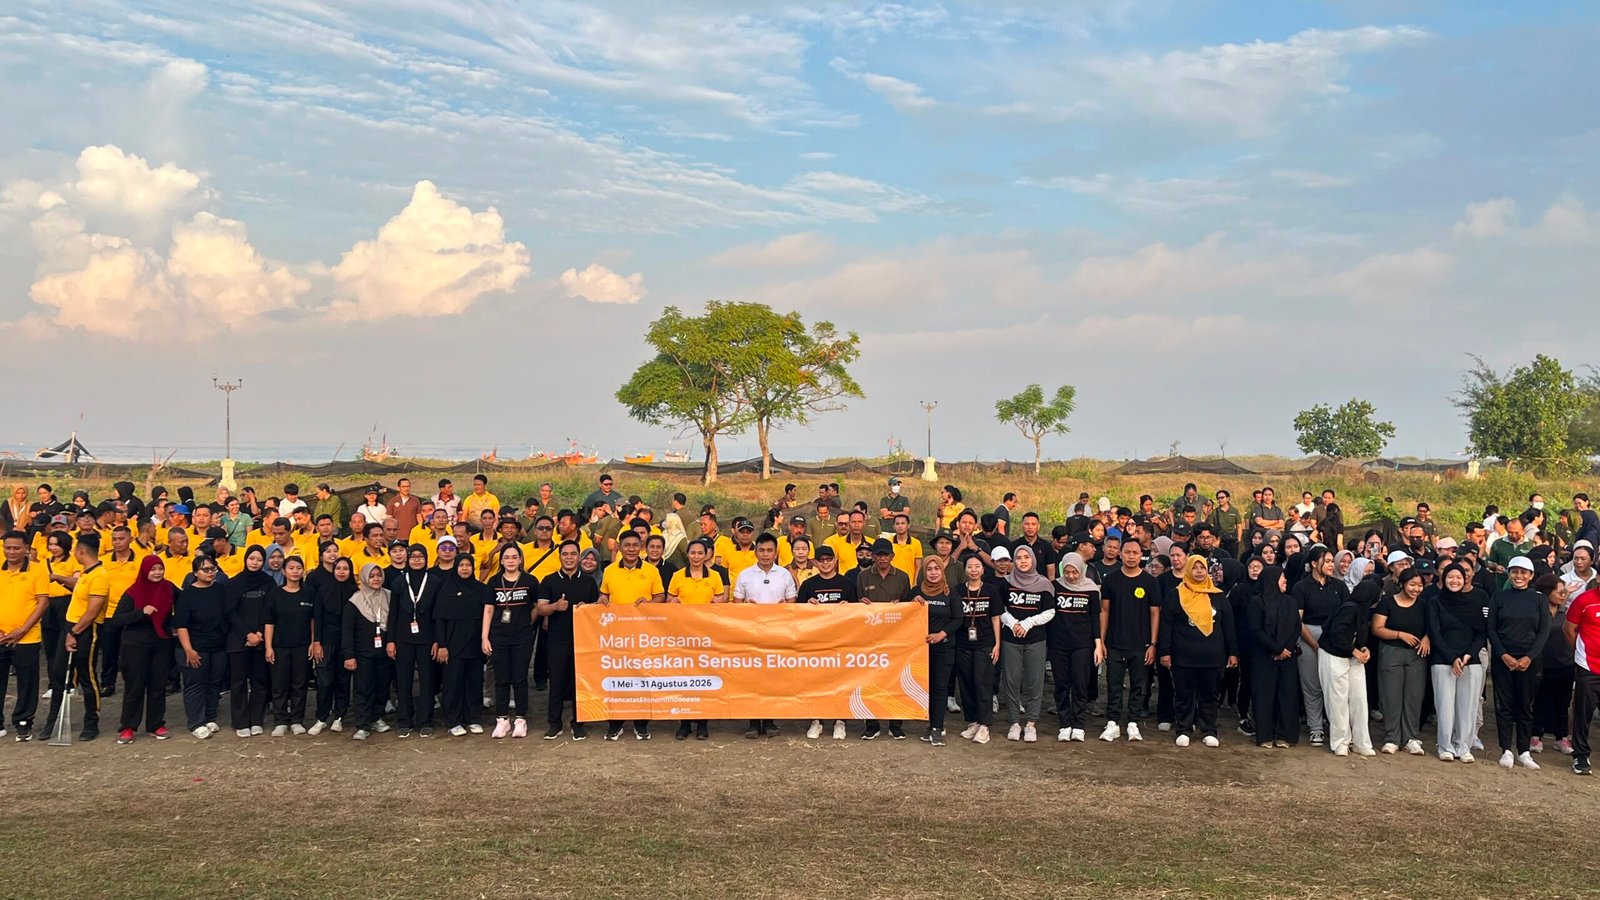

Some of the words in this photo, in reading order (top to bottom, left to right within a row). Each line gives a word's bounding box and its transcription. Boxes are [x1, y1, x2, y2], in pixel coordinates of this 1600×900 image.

[600, 634, 634, 648] Mari
[639, 634, 712, 648] Bersama
[600, 654, 694, 670] Sukseskan
[698, 654, 762, 668] Sensus
[766, 654, 841, 668] Ekonomi
[846, 654, 890, 668] 2026
[651, 680, 688, 690] Agustus
